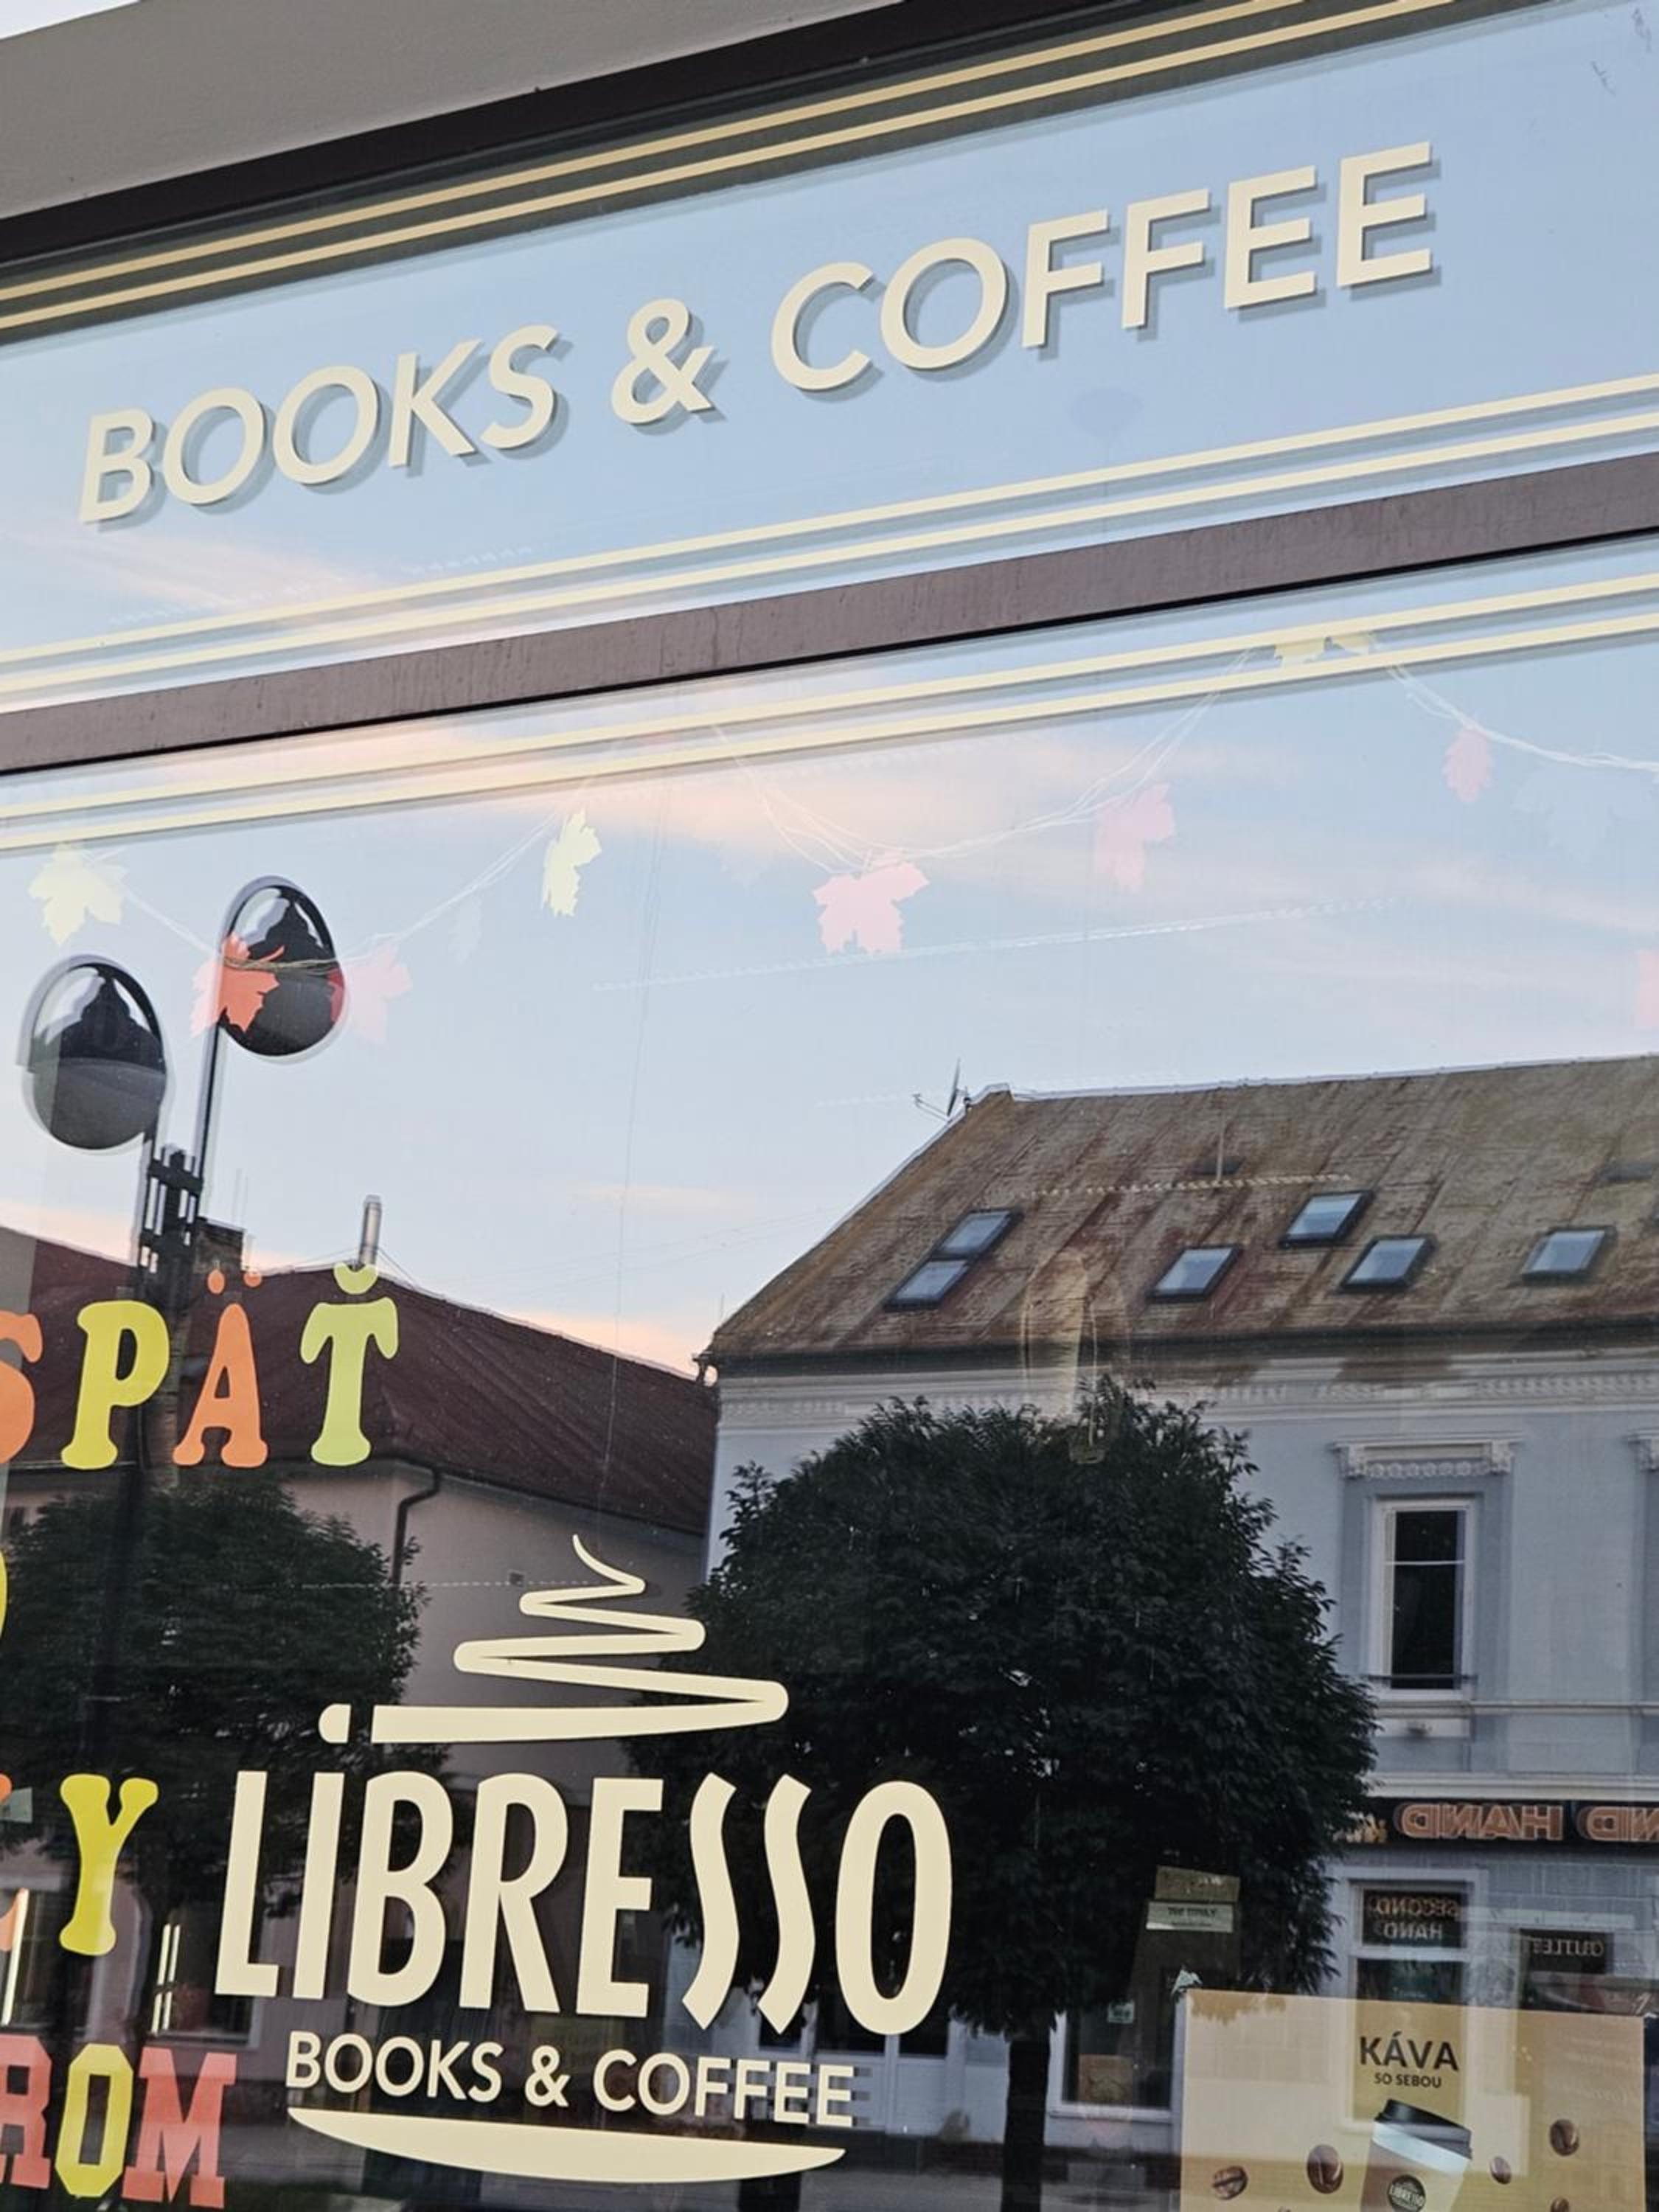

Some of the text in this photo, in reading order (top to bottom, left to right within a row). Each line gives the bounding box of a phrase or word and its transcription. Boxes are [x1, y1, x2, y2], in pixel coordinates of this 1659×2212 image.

[79, 141, 1433, 524] BOOKS & COFFEE
[285, 2031, 854, 2127] BOOKS & COFFEE
[1359, 2030, 1459, 2072] KÁVA
[1374, 2072, 1443, 2090] SO SEBOU
